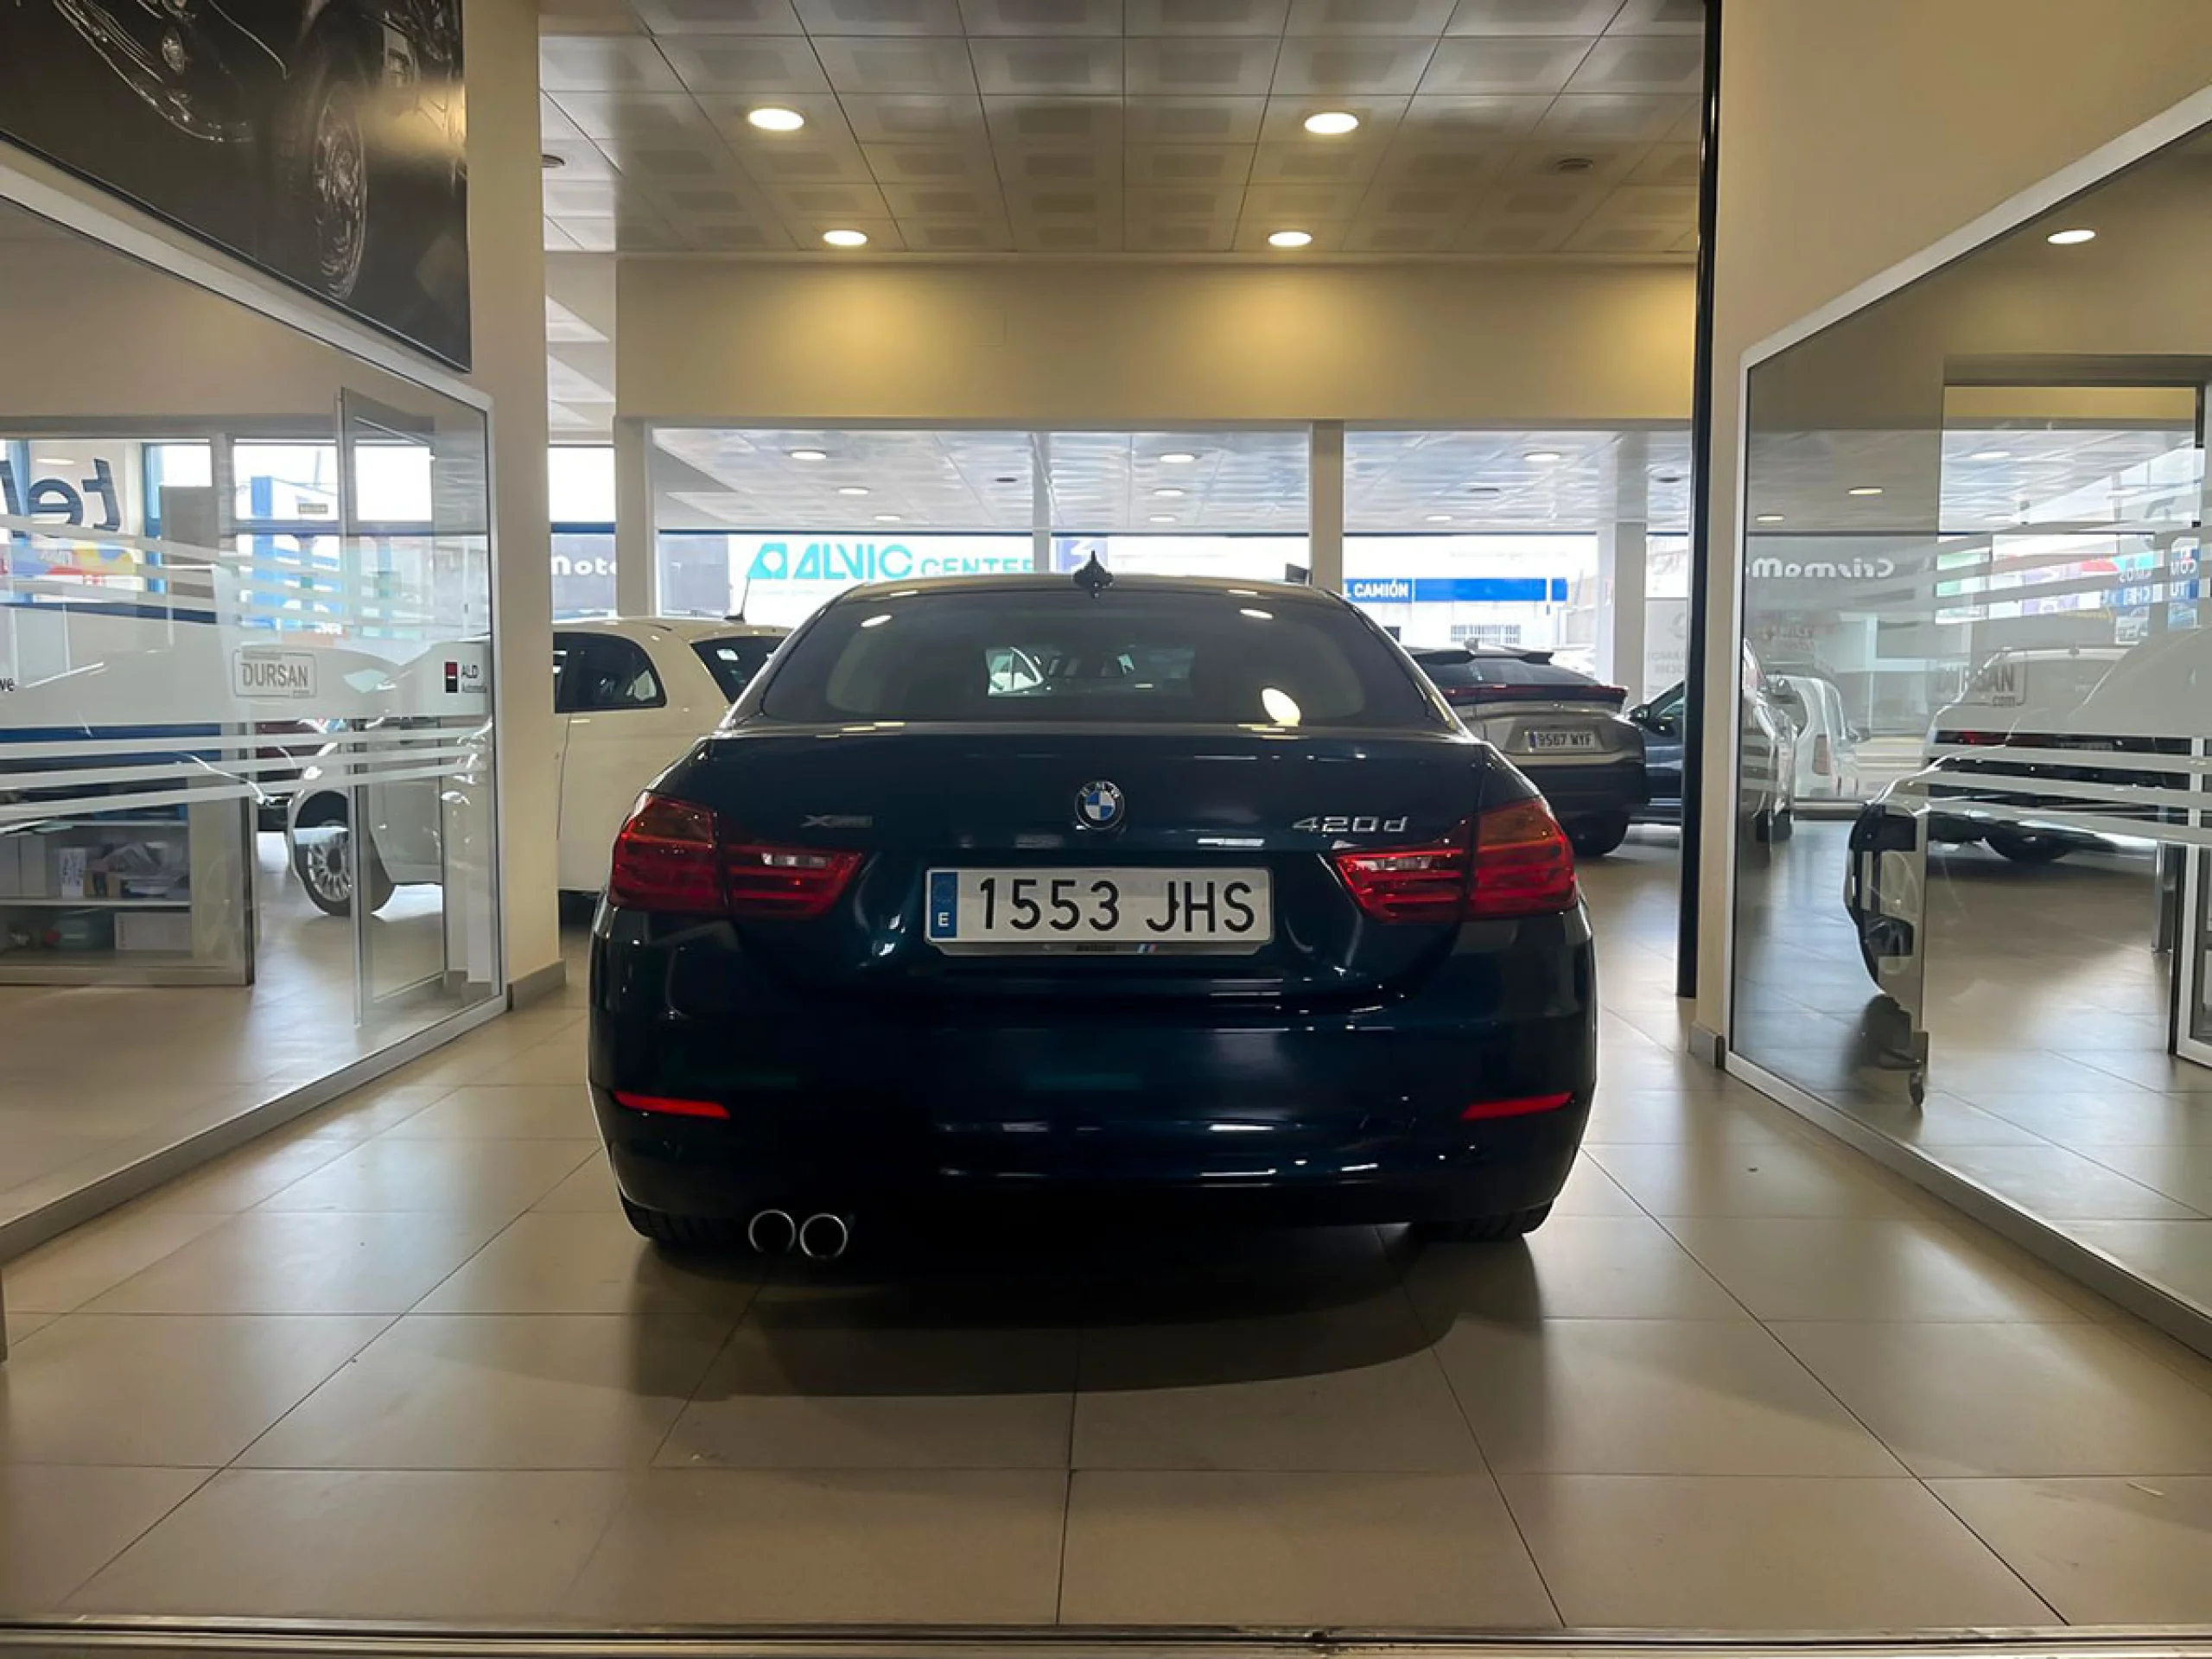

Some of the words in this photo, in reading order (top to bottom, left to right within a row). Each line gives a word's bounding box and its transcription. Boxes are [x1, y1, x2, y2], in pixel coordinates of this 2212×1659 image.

[792, 543, 913, 581] ALVIC
[1354, 579, 1409, 598] CAMIÓN
[239, 663, 309, 688] DURSAN
[1292, 816, 1409, 832] 420d
[980, 877, 1120, 931] 1553
[1146, 880, 1255, 933] JHS
[938, 912, 950, 927] E
